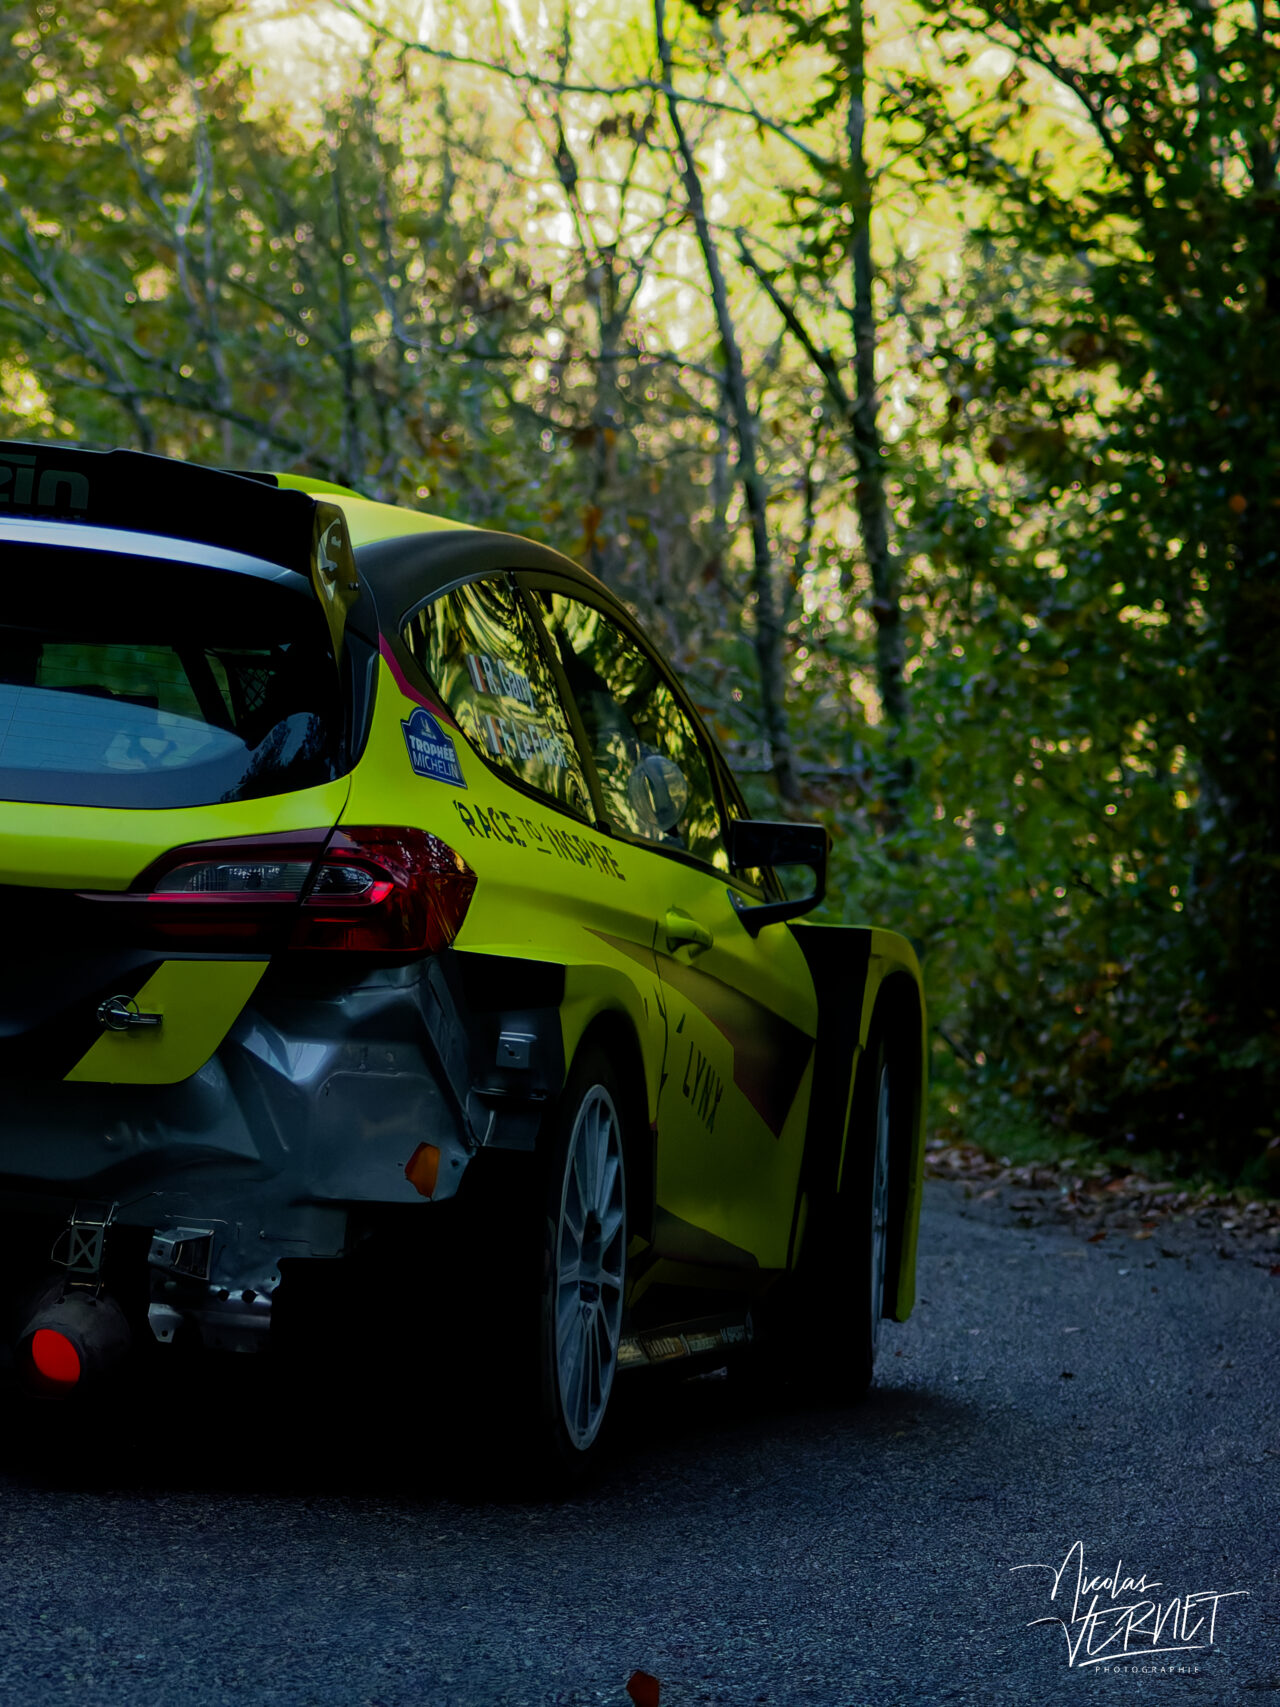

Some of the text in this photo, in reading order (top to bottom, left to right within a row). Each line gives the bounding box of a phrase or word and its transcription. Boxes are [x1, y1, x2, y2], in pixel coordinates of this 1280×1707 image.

[409, 735, 456, 763] TROPHÉE
[510, 720, 533, 761] Le
[412, 750, 460, 780] MICHELIN
[453, 799, 528, 848] RACE
[540, 822, 626, 881] INSPIRE
[682, 1041, 724, 1134] LYNX
